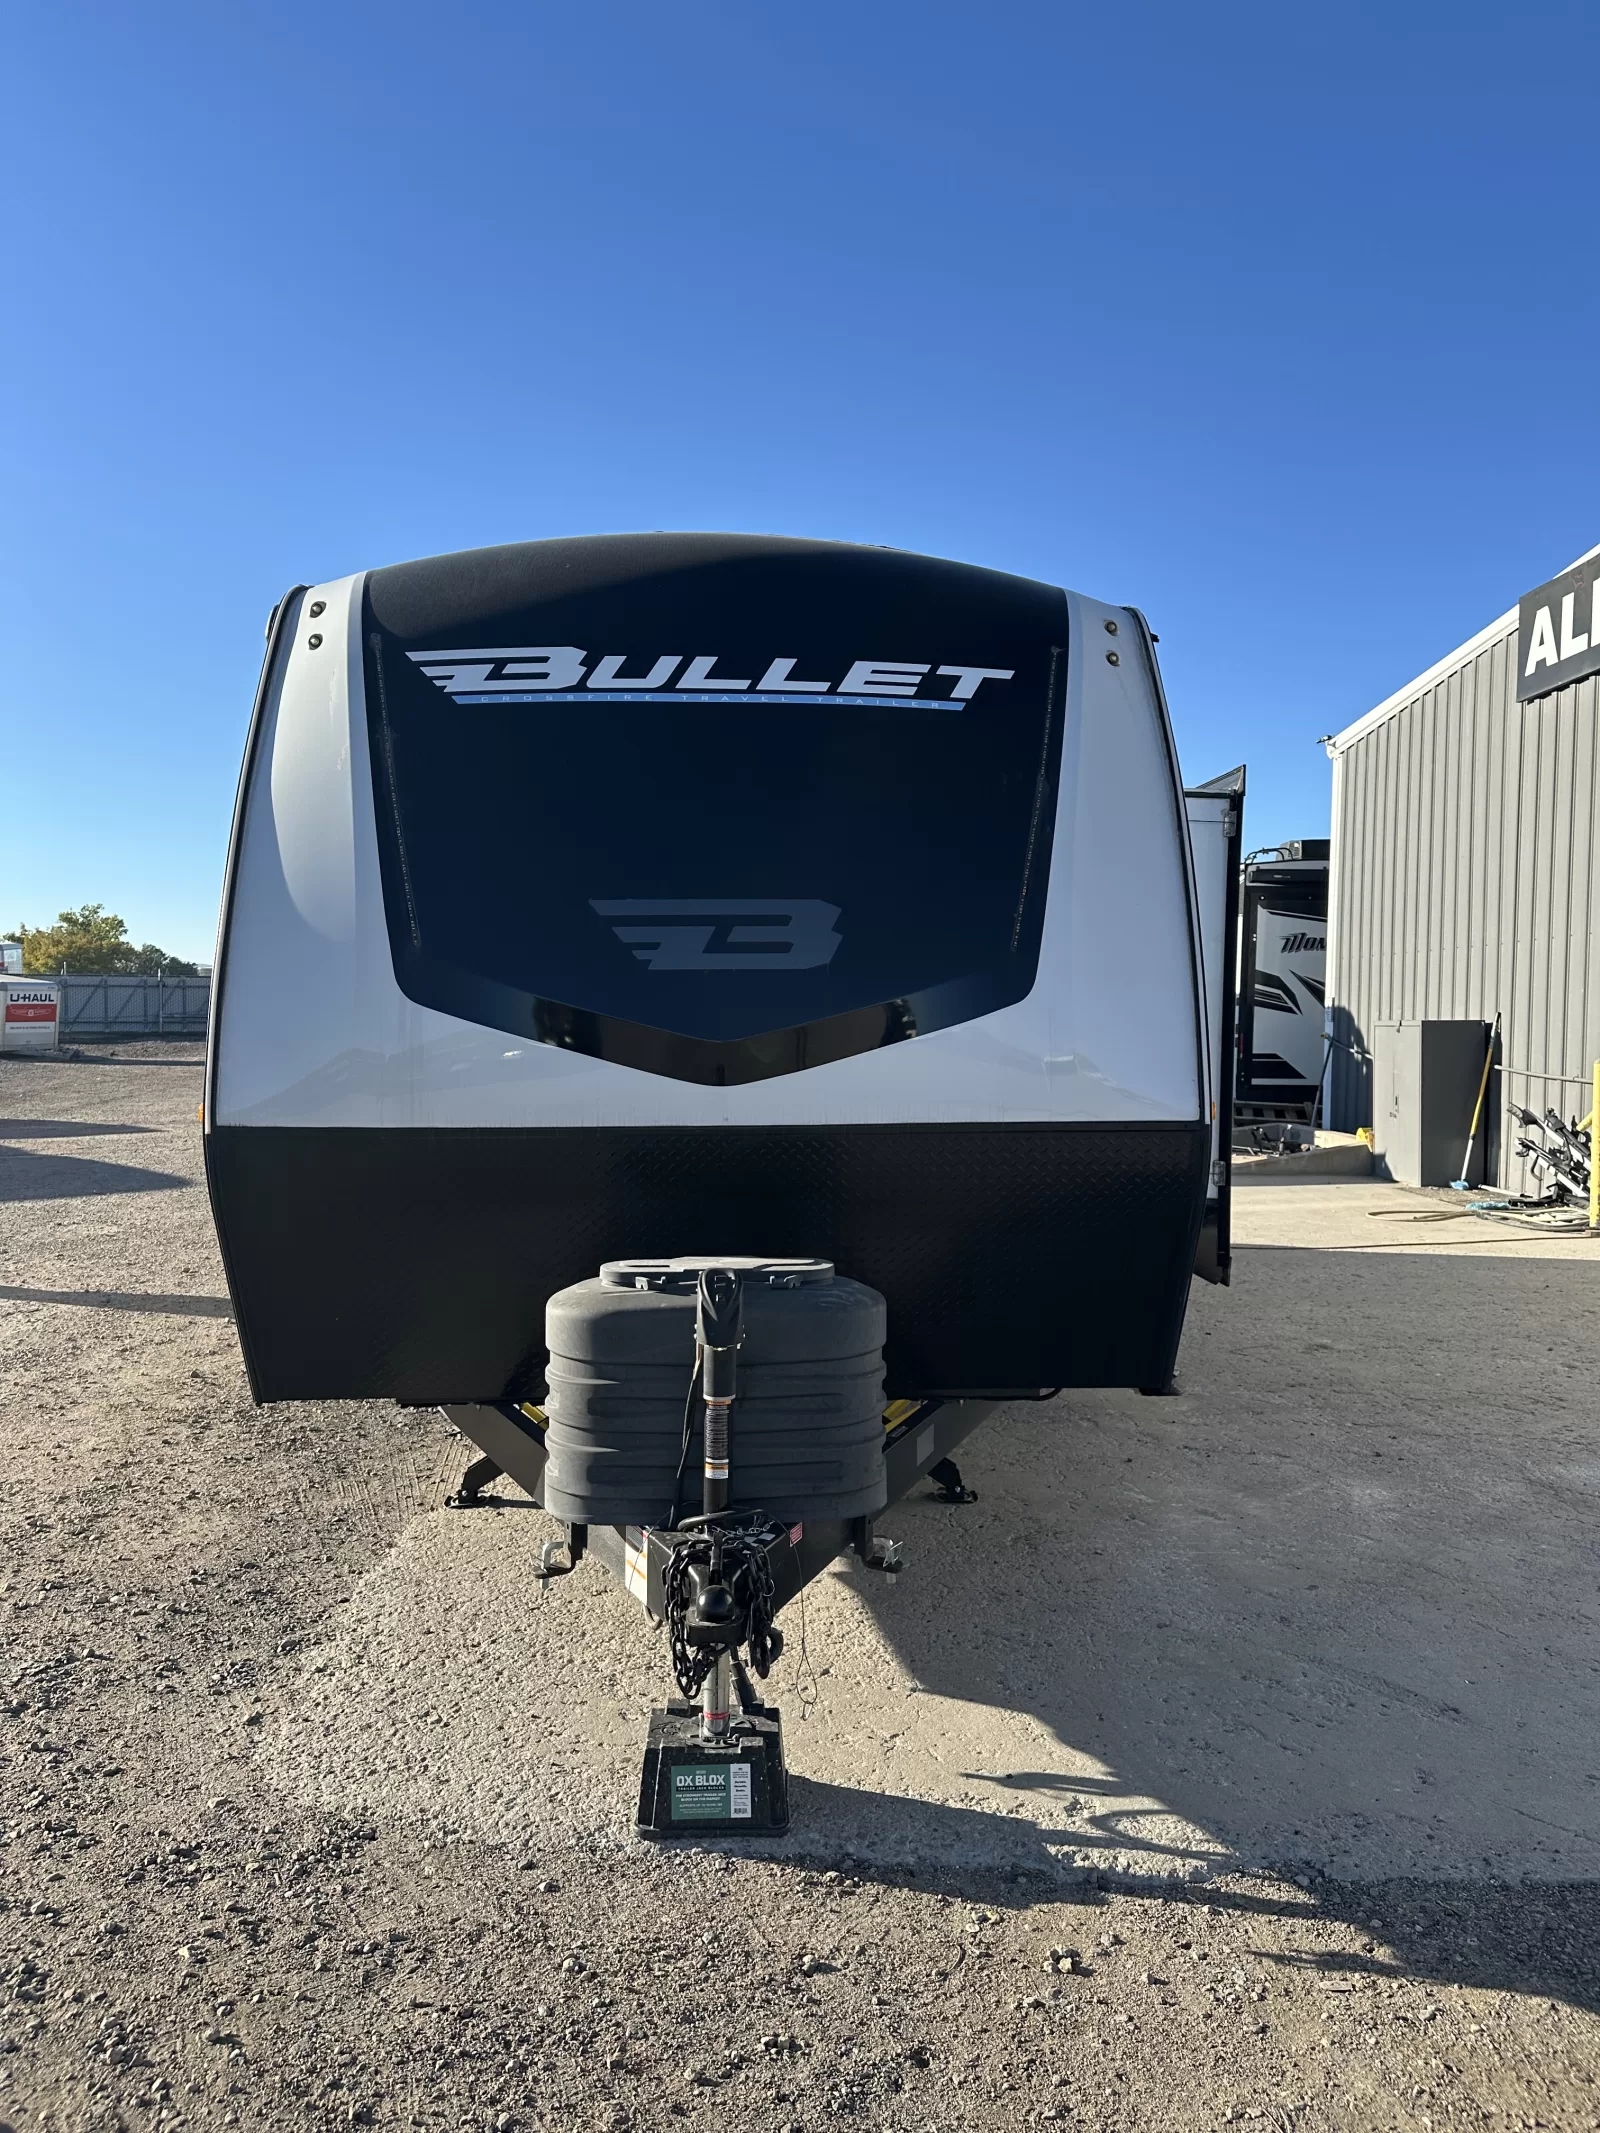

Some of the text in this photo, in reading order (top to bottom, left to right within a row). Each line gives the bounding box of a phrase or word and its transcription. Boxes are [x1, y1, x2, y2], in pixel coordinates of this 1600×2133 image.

[404, 646, 1016, 699] BULLET
[481, 694, 939, 708] CROSSFIRE TRAVEL TRAILER
[10, 993, 54, 1002] U-HAUL
[676, 1775, 693, 1786] OX
[695, 1774, 726, 1786] BLOX
